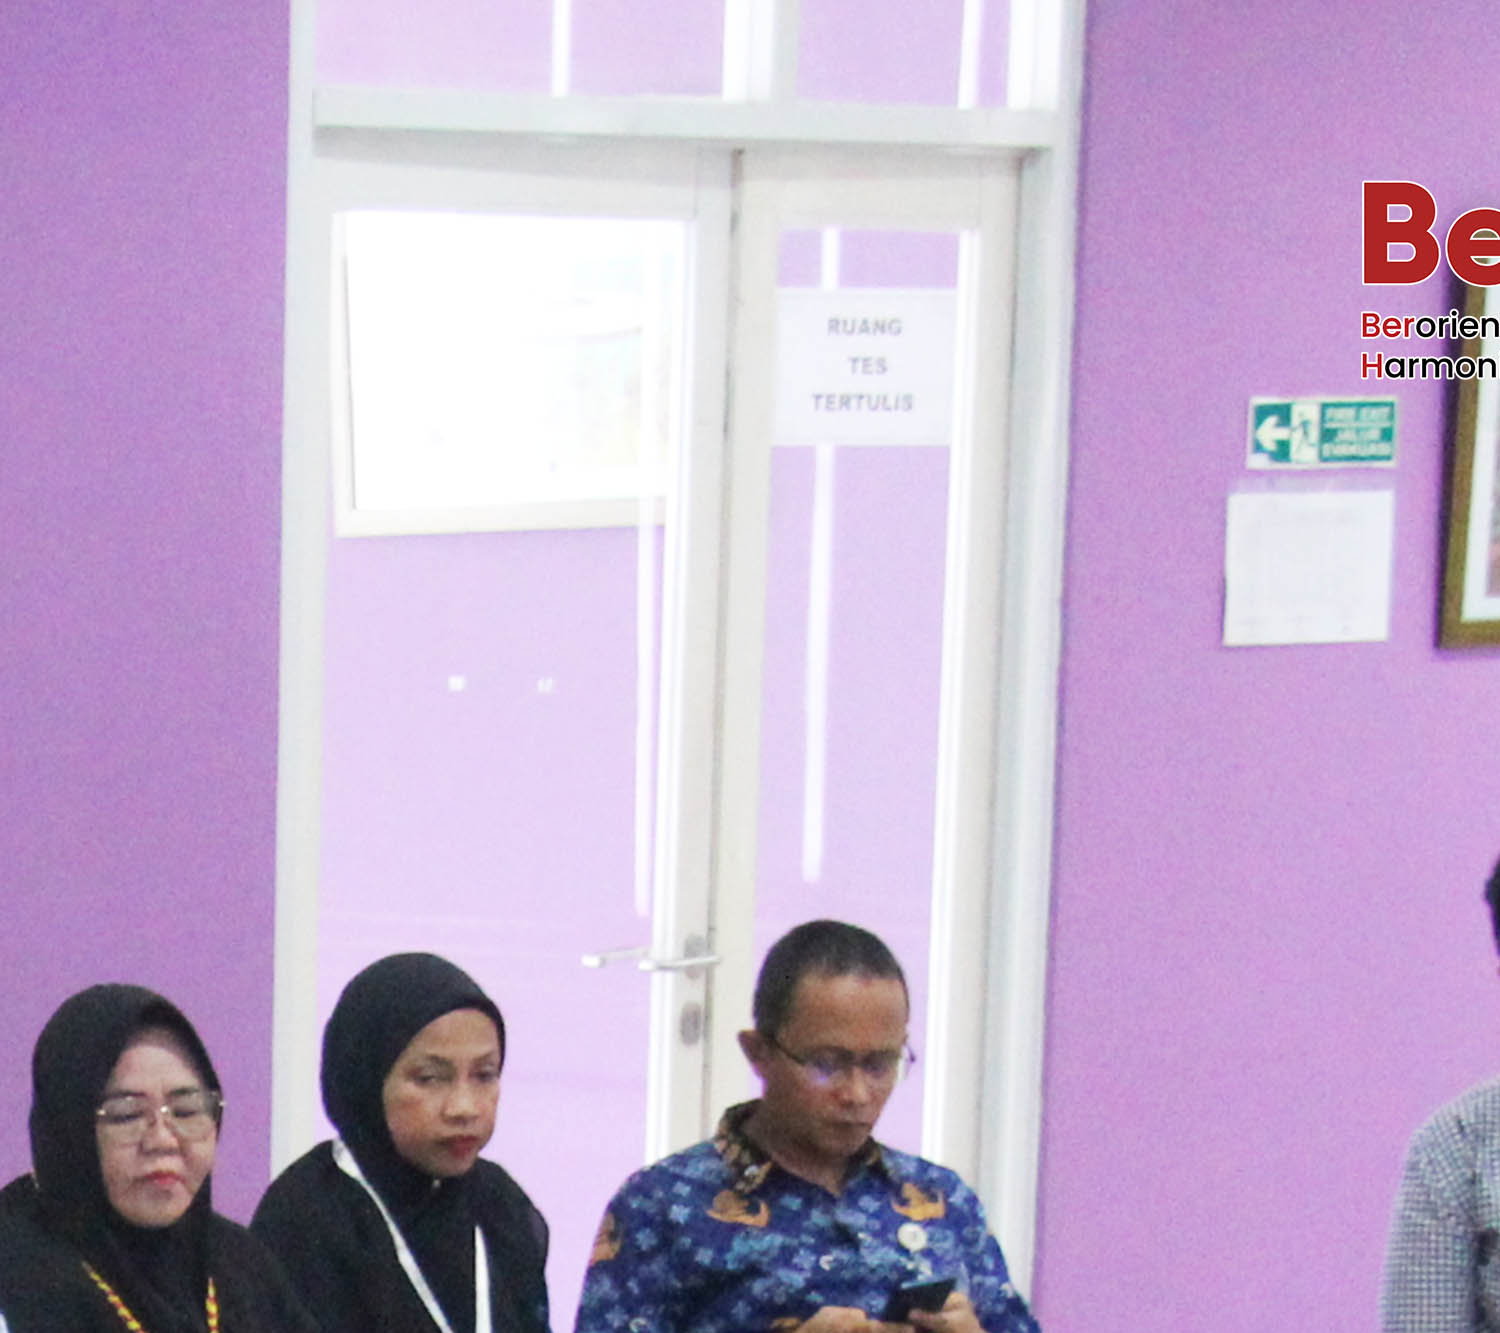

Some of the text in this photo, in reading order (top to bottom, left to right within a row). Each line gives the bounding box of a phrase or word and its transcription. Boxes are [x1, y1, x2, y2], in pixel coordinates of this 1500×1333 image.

[826, 317, 904, 337] RUANG
[847, 356, 889, 376] TES
[811, 393, 914, 413] TERTULIS
